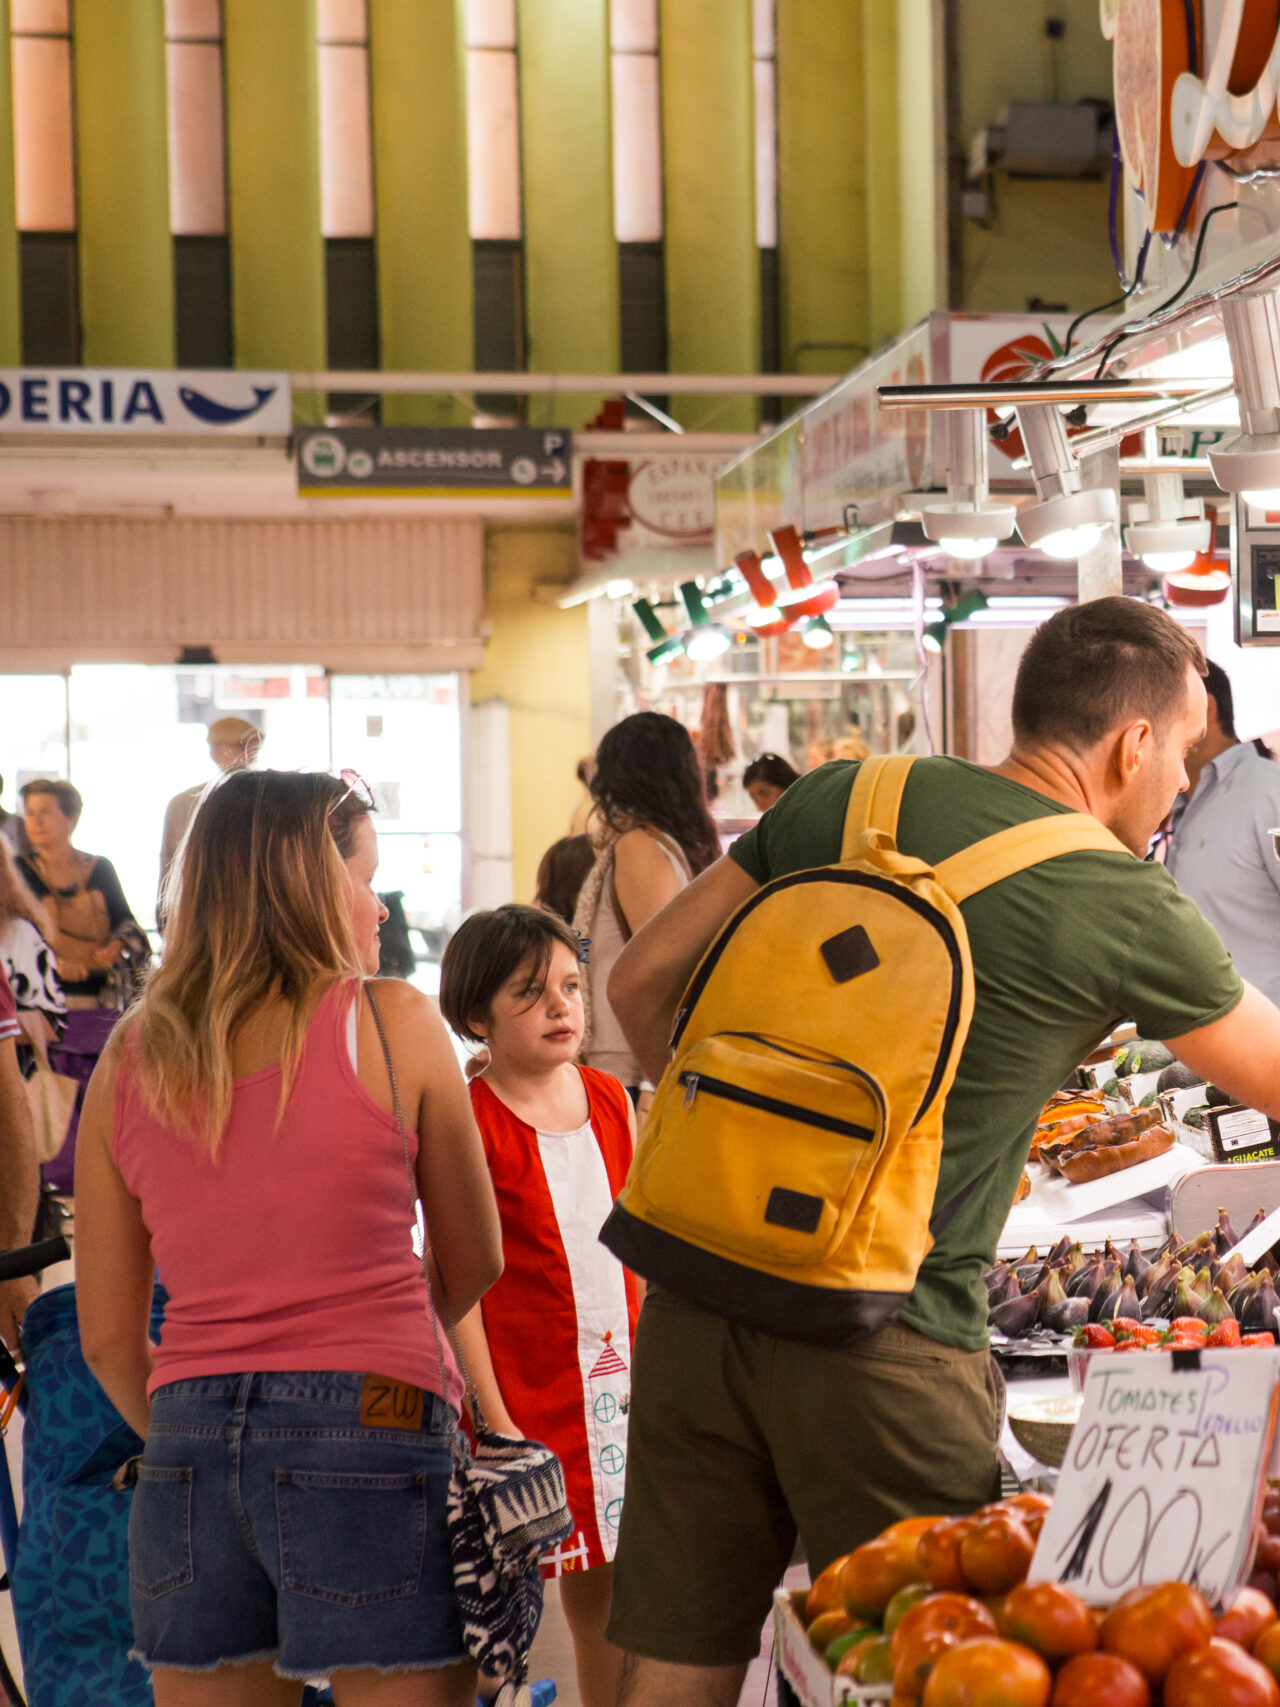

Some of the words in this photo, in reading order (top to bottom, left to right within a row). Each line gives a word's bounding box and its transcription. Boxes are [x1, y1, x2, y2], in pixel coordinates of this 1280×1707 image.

[0, 380, 164, 423] ERIA
[377, 451, 502, 469] ASCENSOR
[366, 1385, 419, 1420] ZW
[1073, 1422, 1222, 1472] OFERTA
